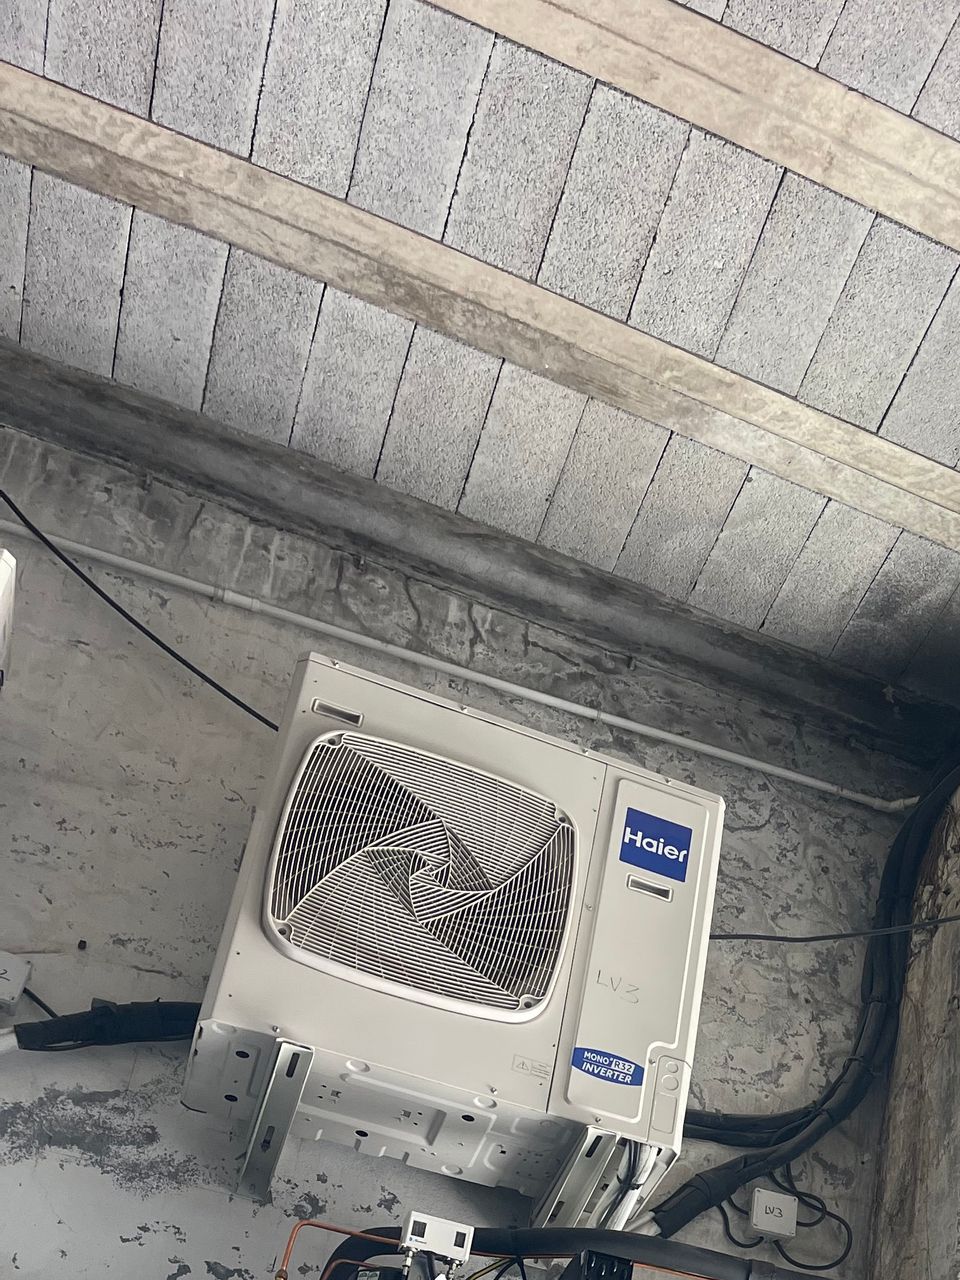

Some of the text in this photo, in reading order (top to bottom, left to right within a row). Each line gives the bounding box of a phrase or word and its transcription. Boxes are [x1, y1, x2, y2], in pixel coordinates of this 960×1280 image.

[624, 826, 688, 863] Haier
[596, 969, 640, 1005] LV3
[582, 1061, 632, 1084] INVERTER
[613, 1060, 633, 1072] R32
[764, 1205, 783, 1218] LV3
